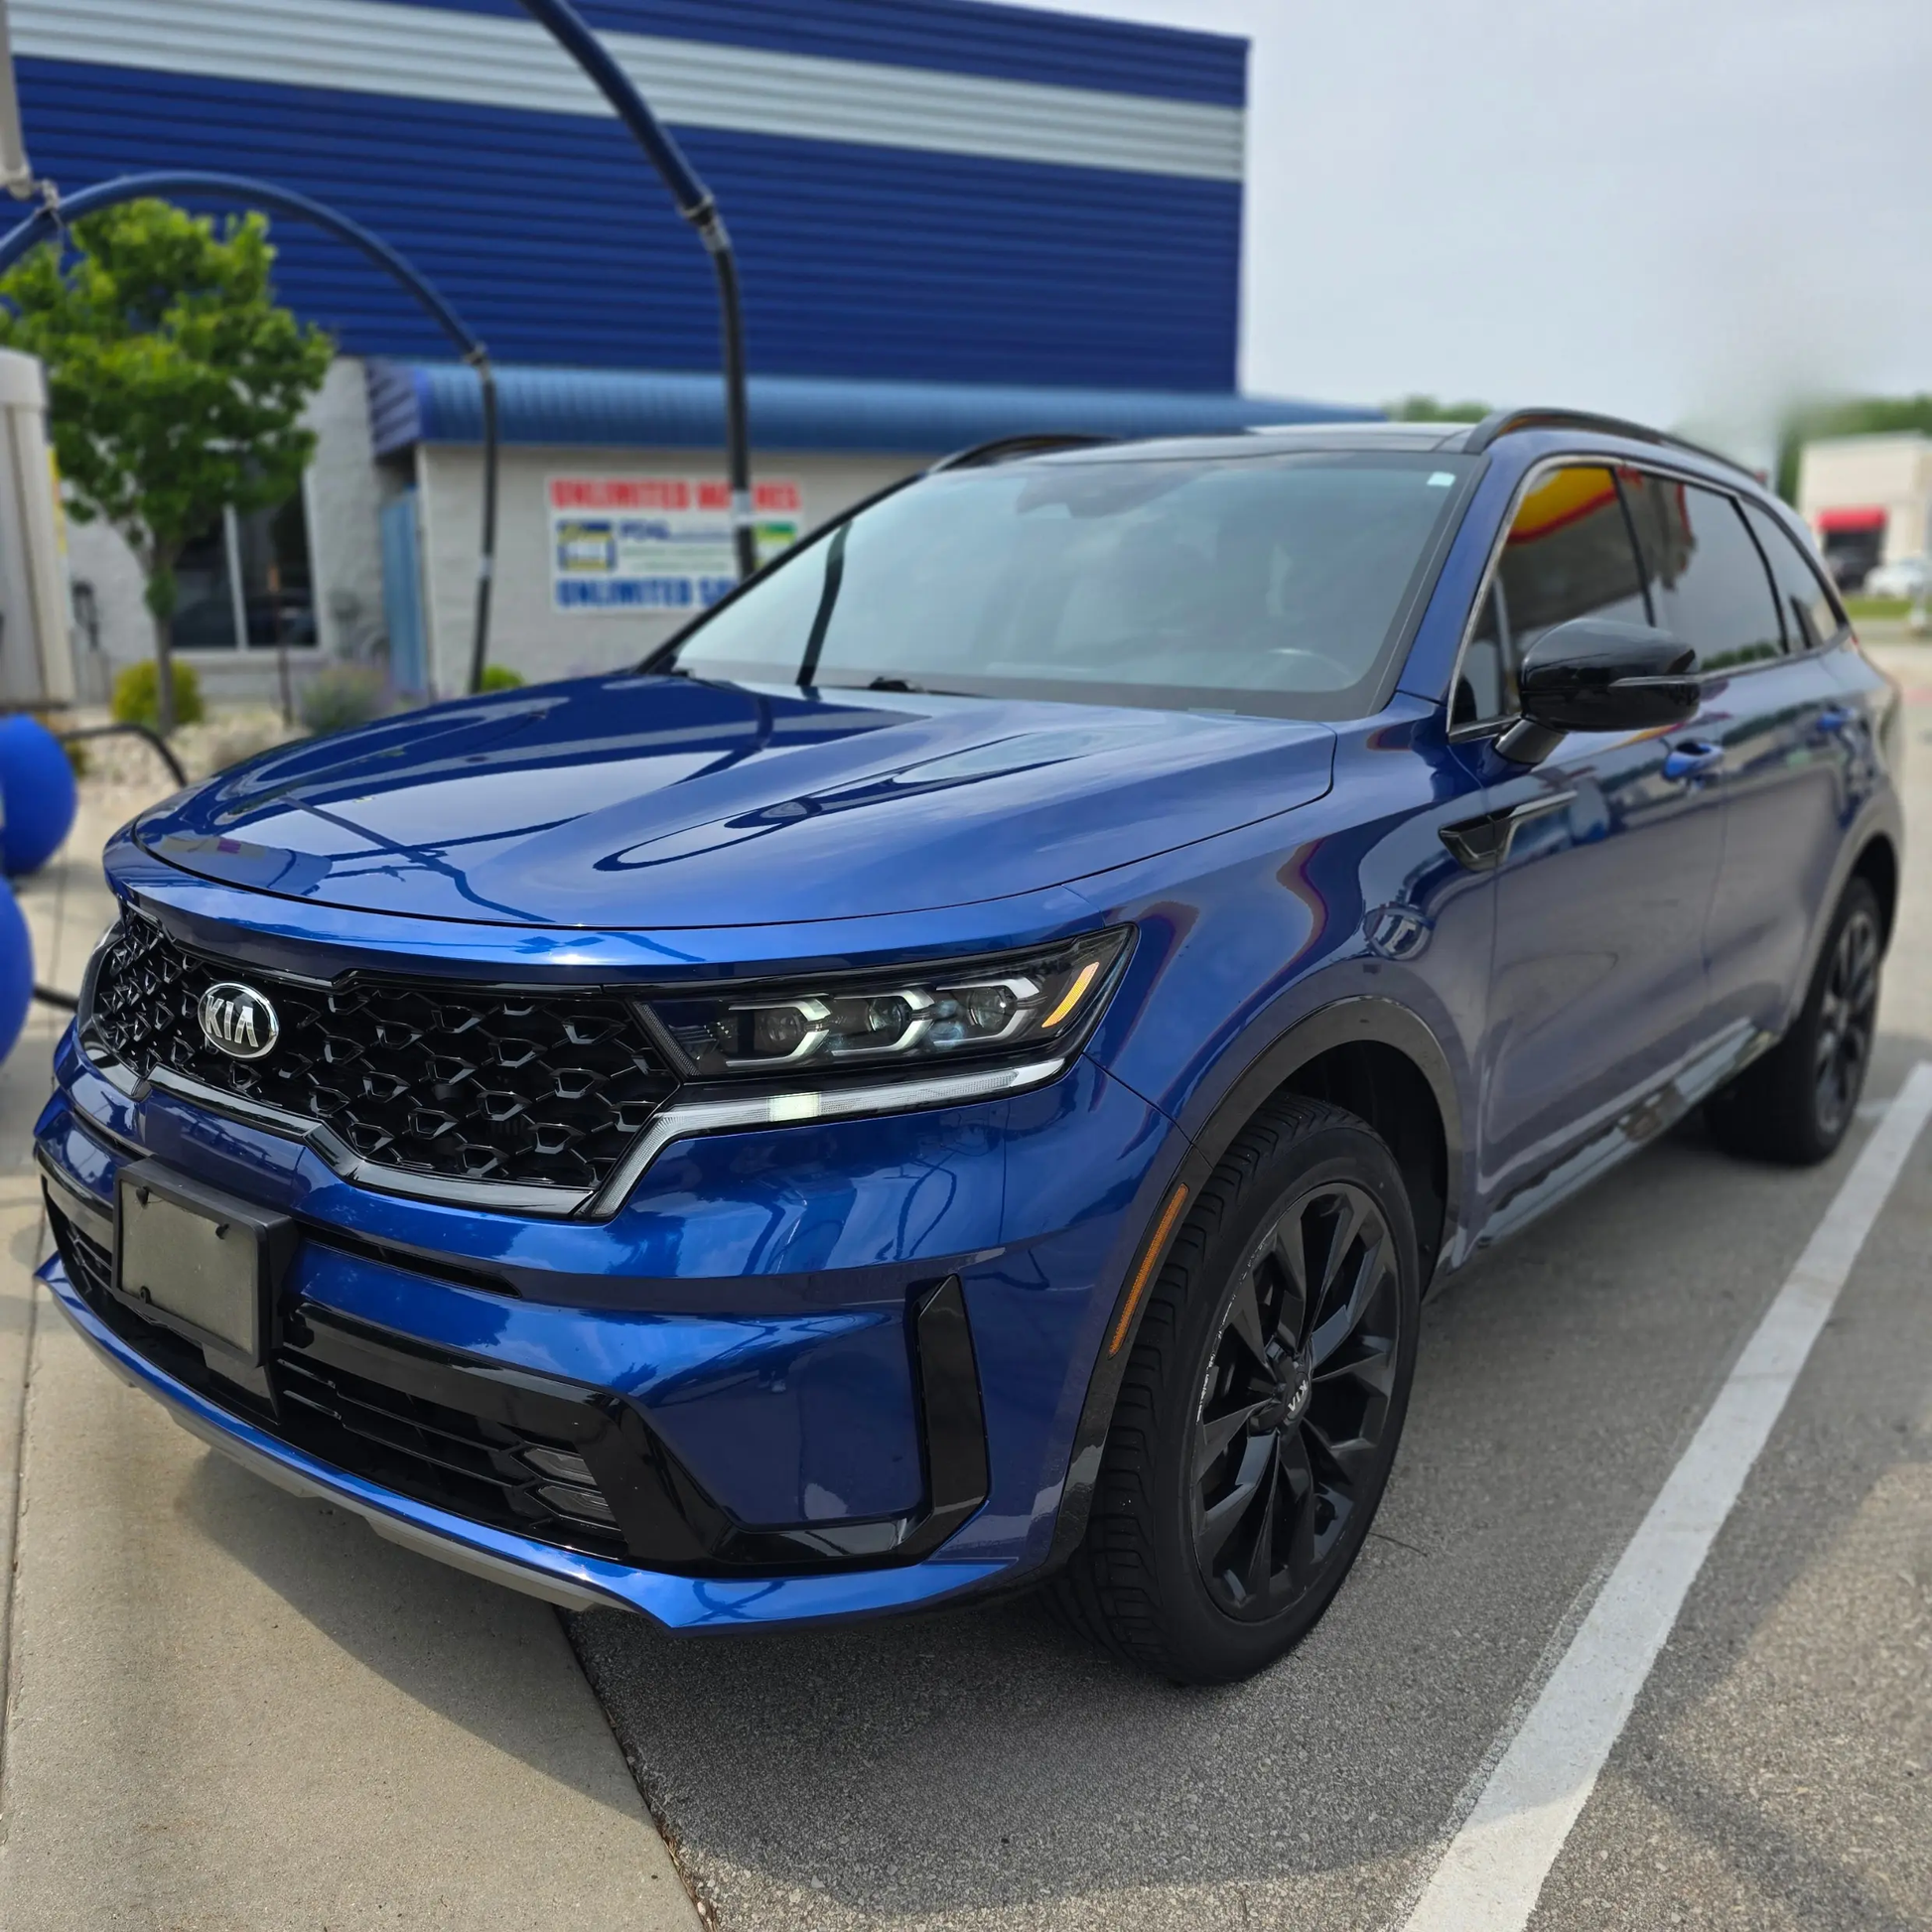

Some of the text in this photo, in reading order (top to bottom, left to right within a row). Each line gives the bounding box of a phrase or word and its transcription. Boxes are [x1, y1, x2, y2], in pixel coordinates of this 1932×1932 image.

[551, 479, 800, 511] UNLIMITED WAHES
[556, 577, 693, 607] UNLIMITED
[206, 994, 259, 1047] KIA
